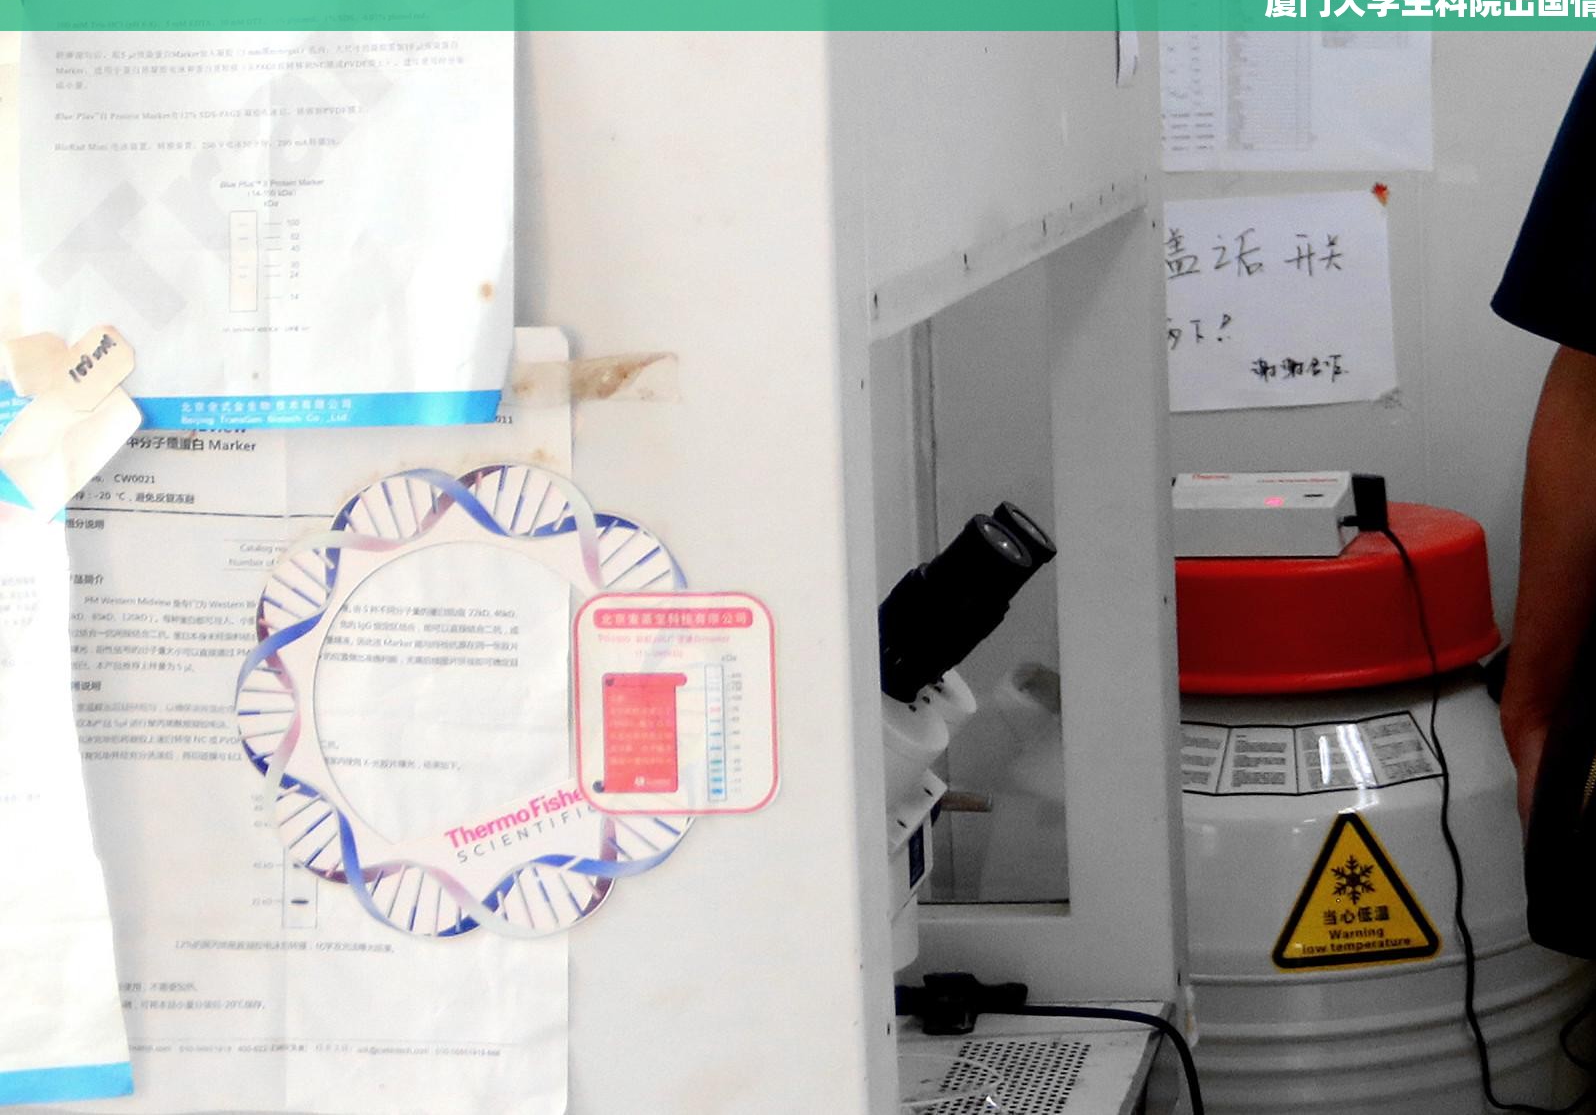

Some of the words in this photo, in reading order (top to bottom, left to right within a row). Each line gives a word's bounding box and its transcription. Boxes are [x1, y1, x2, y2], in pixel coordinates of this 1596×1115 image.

[209, 440, 256, 451] Marker
[114, 474, 155, 484] CW0021
[444, 788, 584, 849] ThermoFishe
[1323, 905, 1390, 925] 当心低温
[1328, 927, 1385, 940] Warning
[1302, 944, 1328, 954] low
[1330, 937, 1411, 953] temperature
